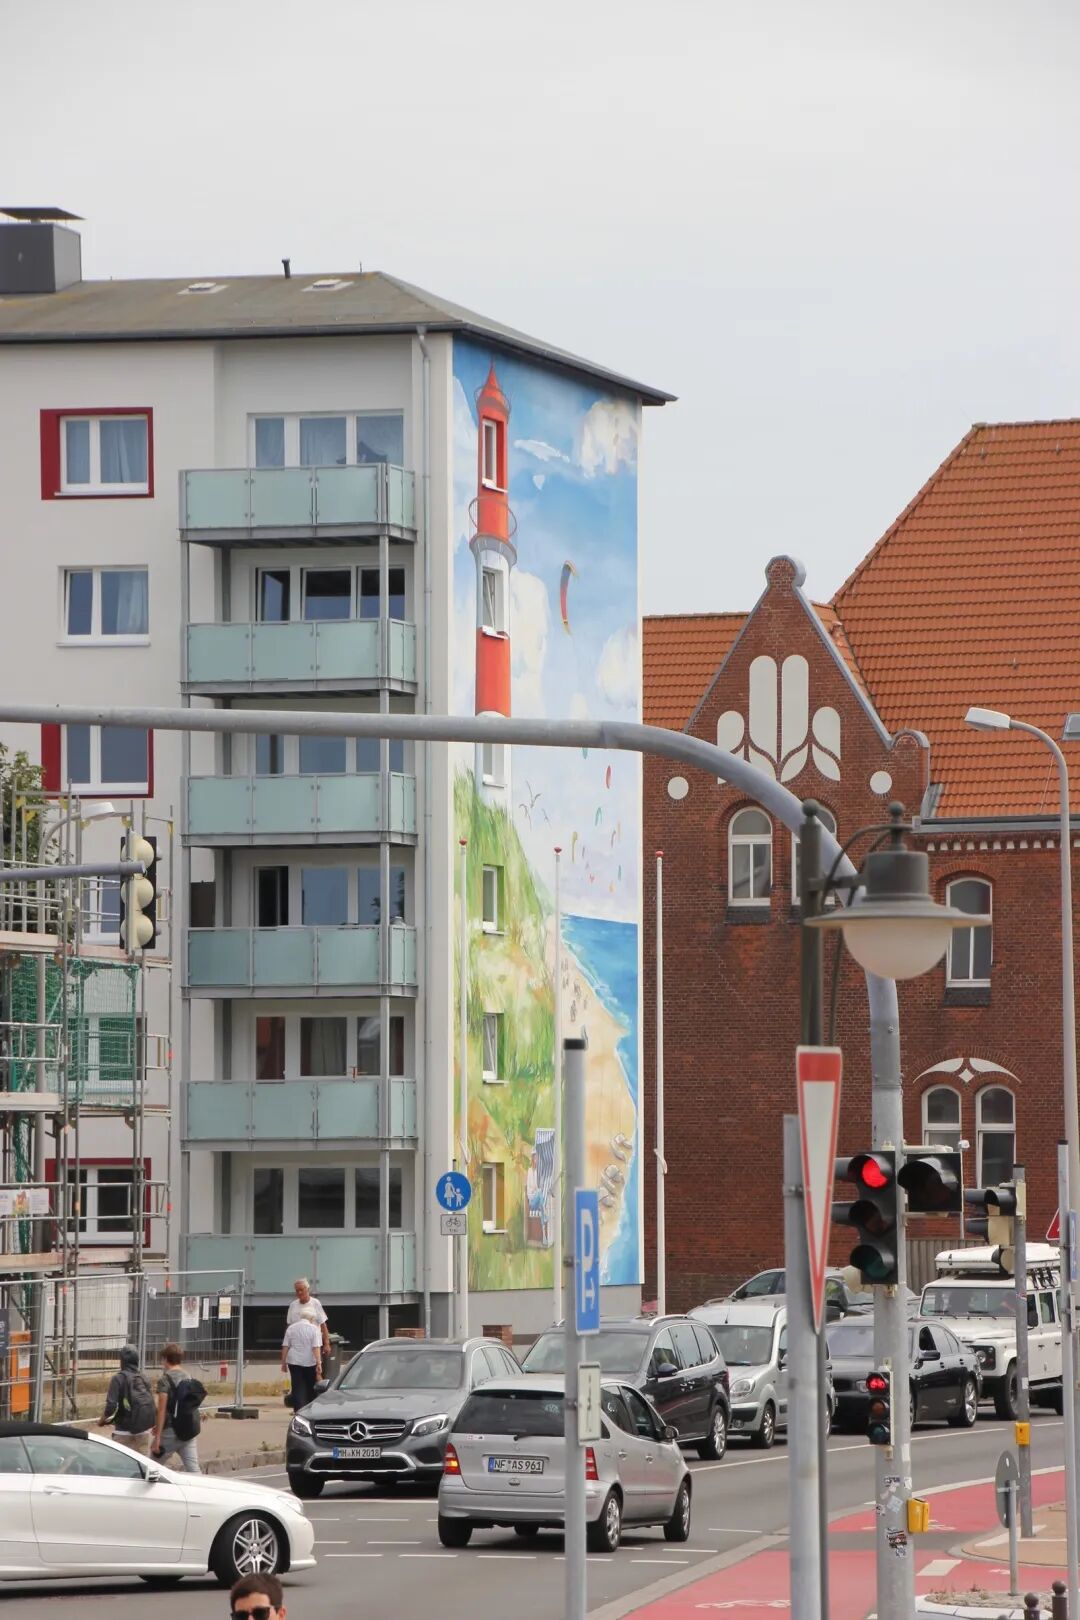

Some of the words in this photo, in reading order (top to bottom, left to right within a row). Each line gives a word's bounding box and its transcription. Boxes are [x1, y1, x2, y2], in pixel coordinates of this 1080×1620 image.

[581, 1209, 593, 1312] P
[351, 1449, 360, 1457] KH
[362, 1449, 379, 1457] 2018
[494, 1459, 506, 1468] NF
[511, 1460, 523, 1470] AS
[525, 1461, 541, 1471] 961
